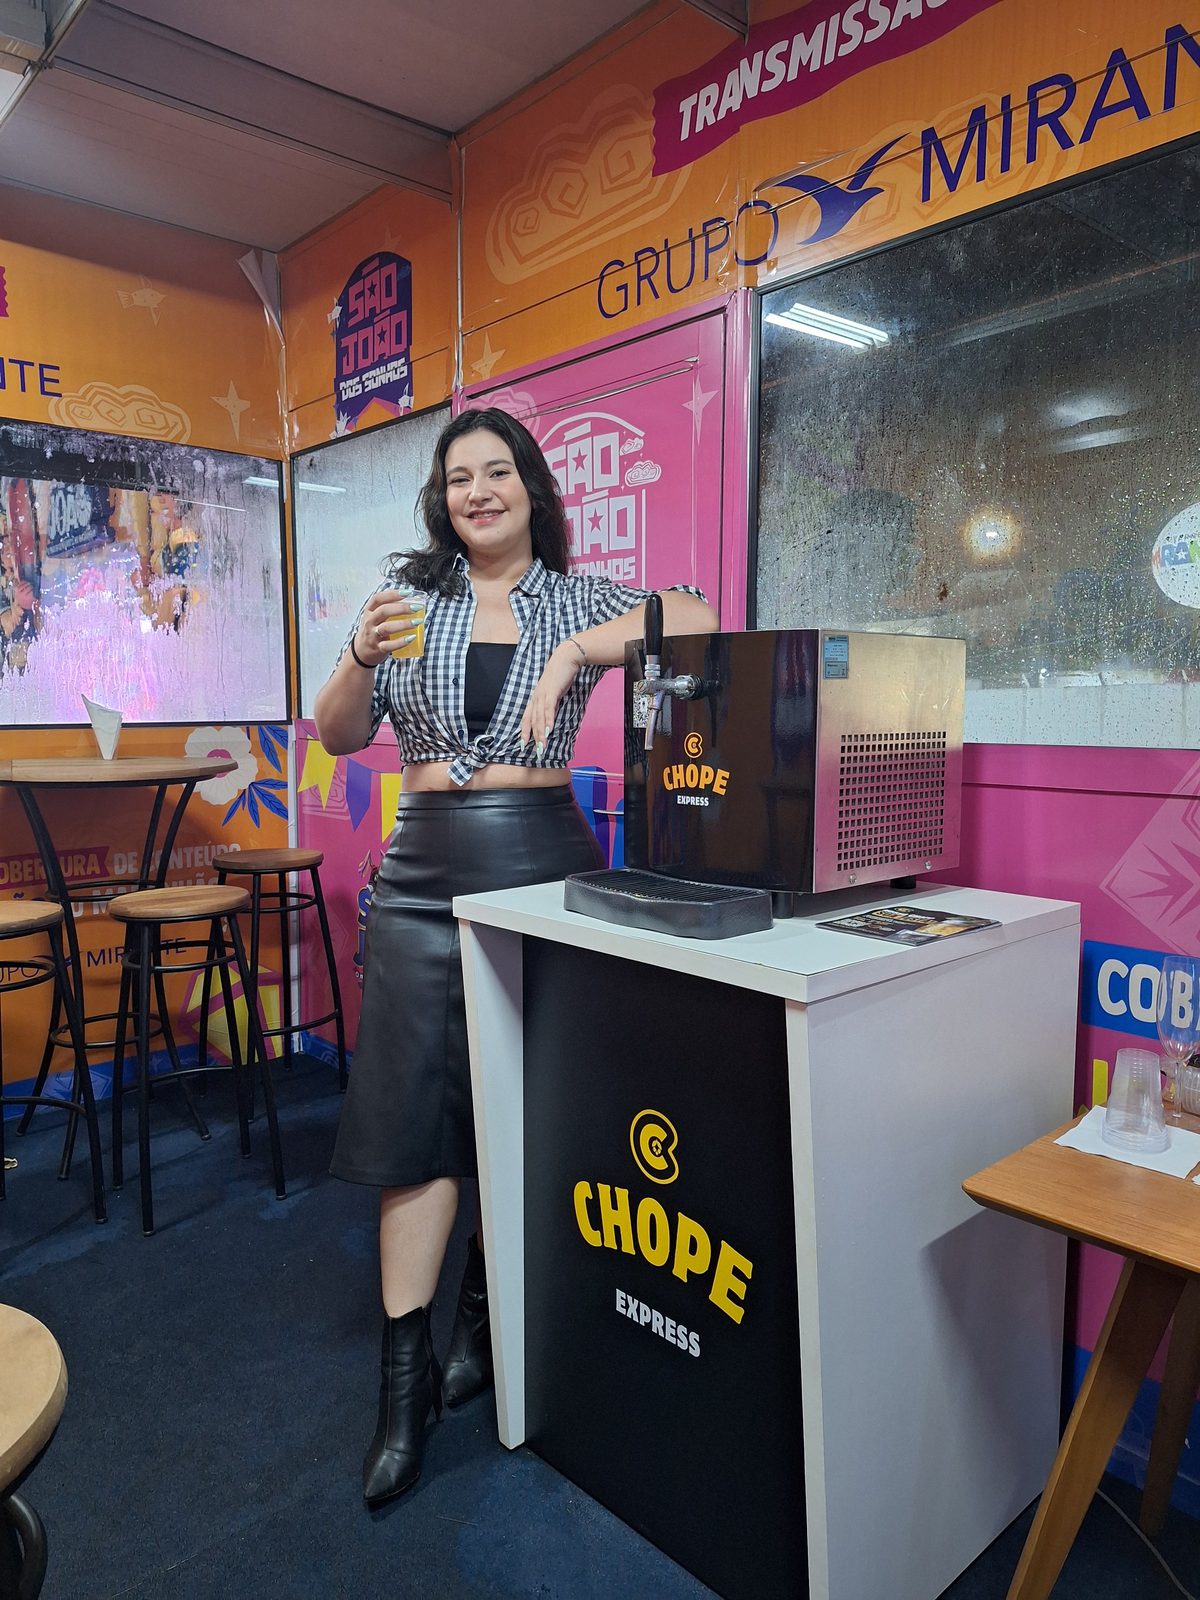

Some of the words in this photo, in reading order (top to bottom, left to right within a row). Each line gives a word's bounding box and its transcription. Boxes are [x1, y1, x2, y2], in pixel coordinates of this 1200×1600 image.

[679, 0, 948, 142] TRANSMISS
[348, 257, 398, 328] SÃO
[597, 200, 779, 319] GRUPO
[340, 308, 408, 375] JOÃO
[0, 356, 63, 398] TE
[339, 375, 363, 402] DOS
[361, 357, 408, 393] SONHOS
[565, 489, 636, 557] OÃO
[663, 763, 730, 796] CHOPE
[676, 795, 710, 807] EXPRESS
[0, 853, 101, 885] OBERURA
[113, 851, 139, 876] DE
[1097, 958, 1200, 1032] COB
[574, 1180, 754, 1325] CHOPE
[615, 1287, 701, 1358] EXPRESS
